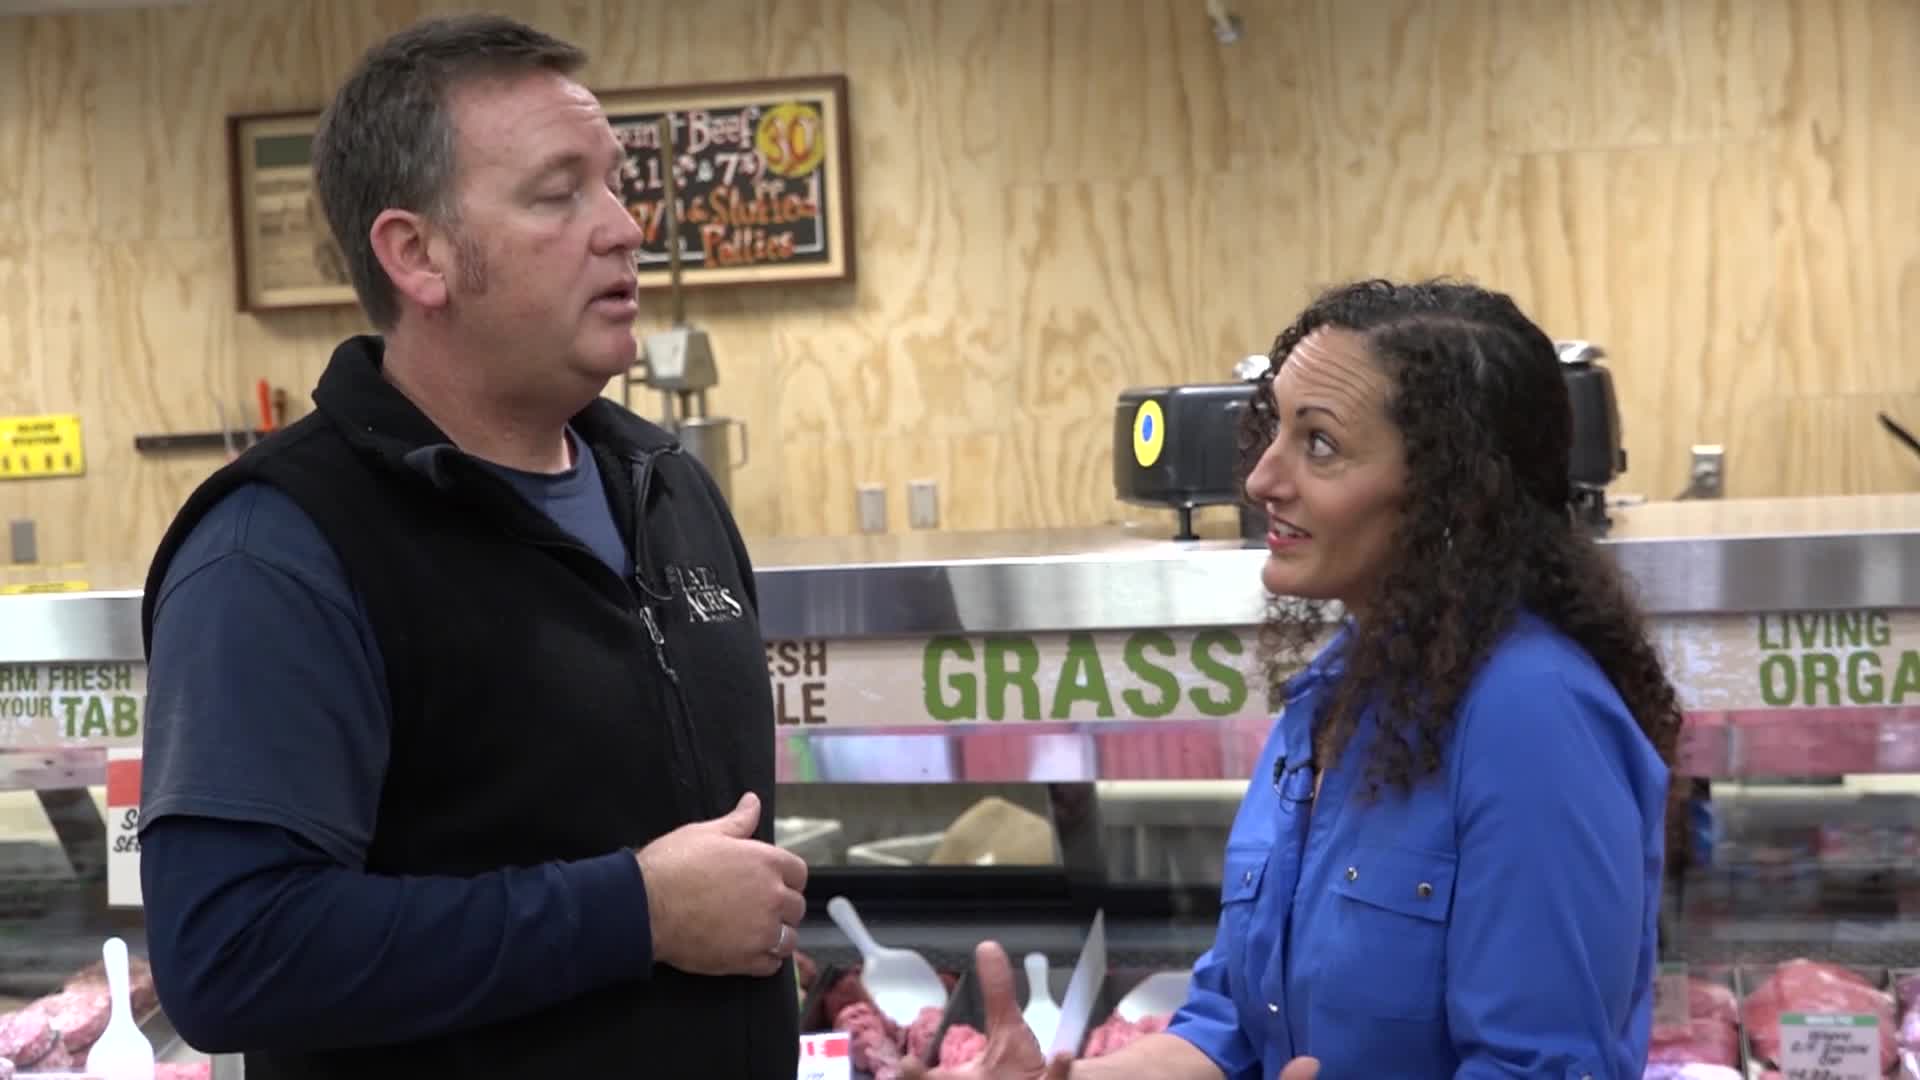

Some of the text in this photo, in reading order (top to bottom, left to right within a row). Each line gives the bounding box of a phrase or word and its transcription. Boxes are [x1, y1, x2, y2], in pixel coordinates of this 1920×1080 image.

[1759, 610, 1890, 650] LIVING
[48, 664, 131, 691] FRESH
[923, 630, 1248, 721] GRASS
[1759, 650, 1920, 705] ORGA
[0, 696, 139, 737] YOUR TAB
